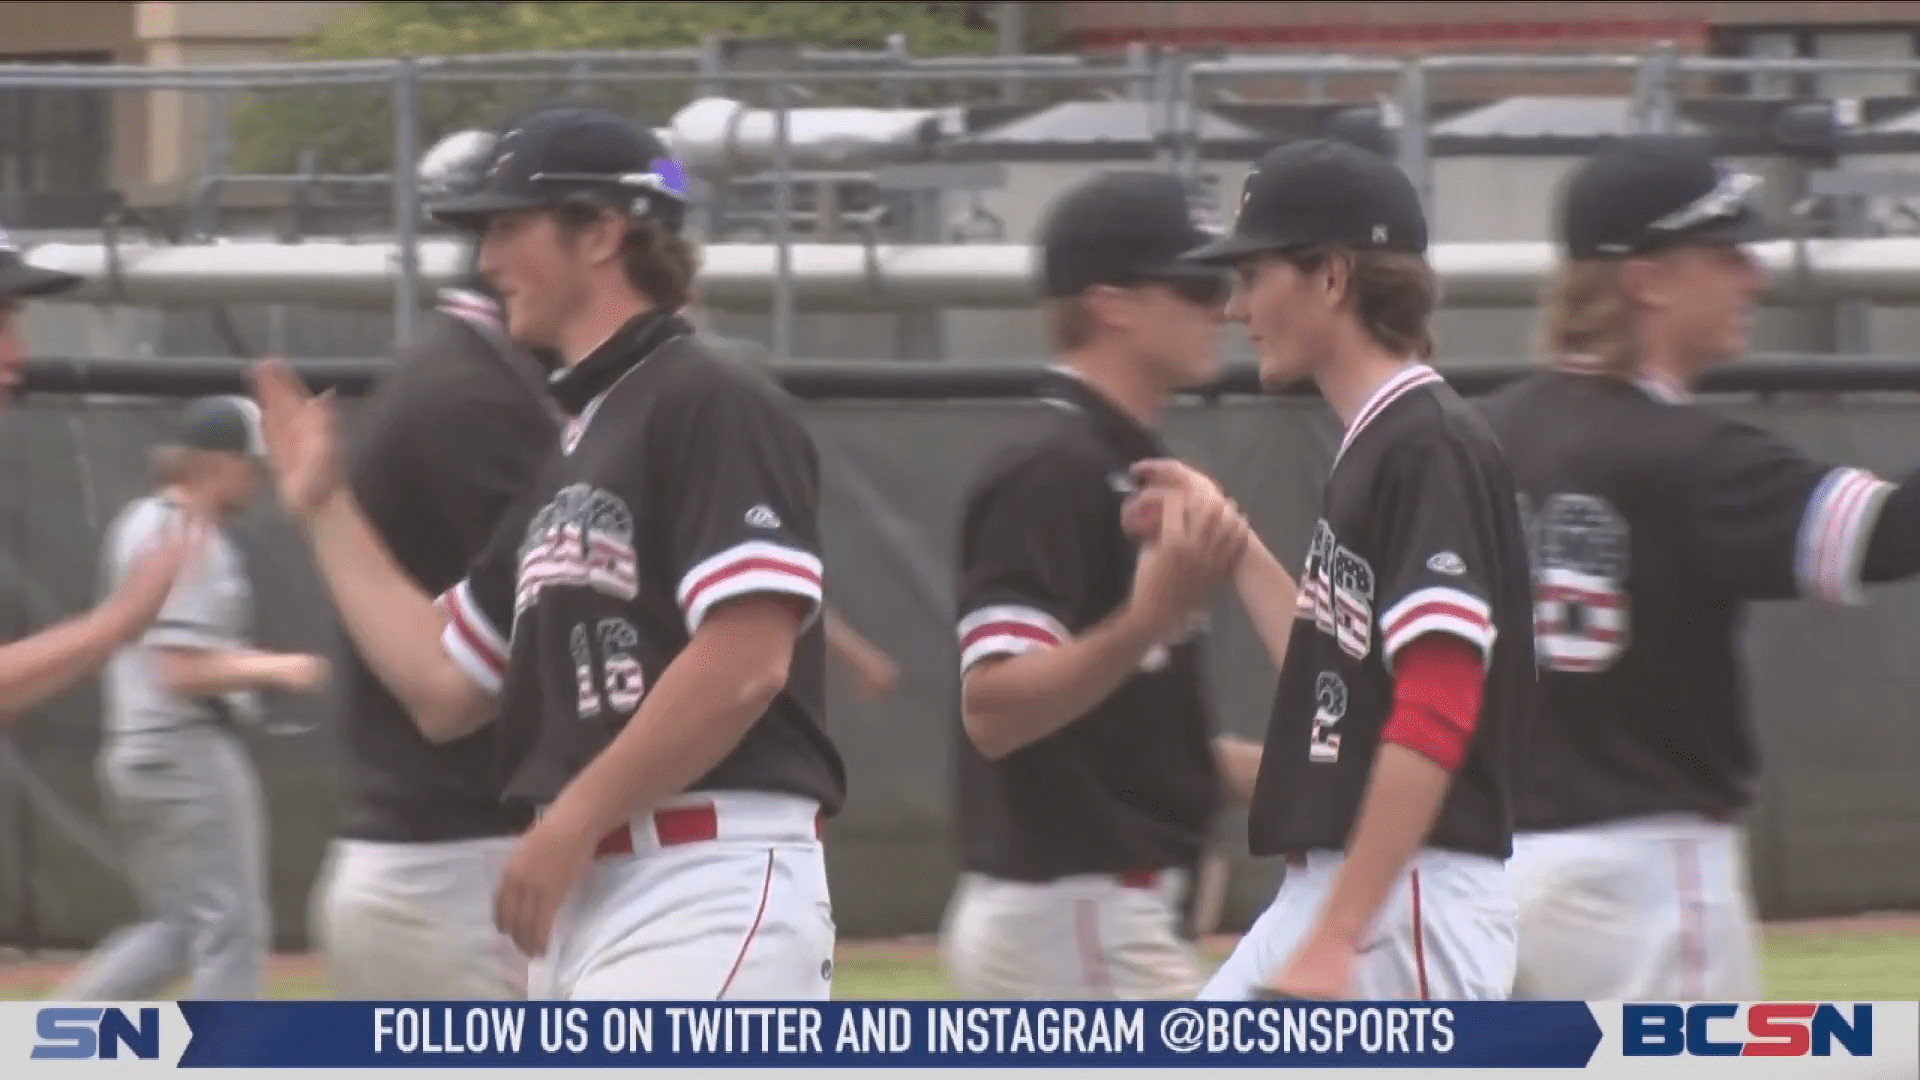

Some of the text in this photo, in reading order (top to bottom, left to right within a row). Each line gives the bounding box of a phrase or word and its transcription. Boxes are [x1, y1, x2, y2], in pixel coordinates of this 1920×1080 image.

[1517, 492, 1632, 674] 8
[571, 619, 644, 718] 16
[1309, 671, 1347, 762] 2
